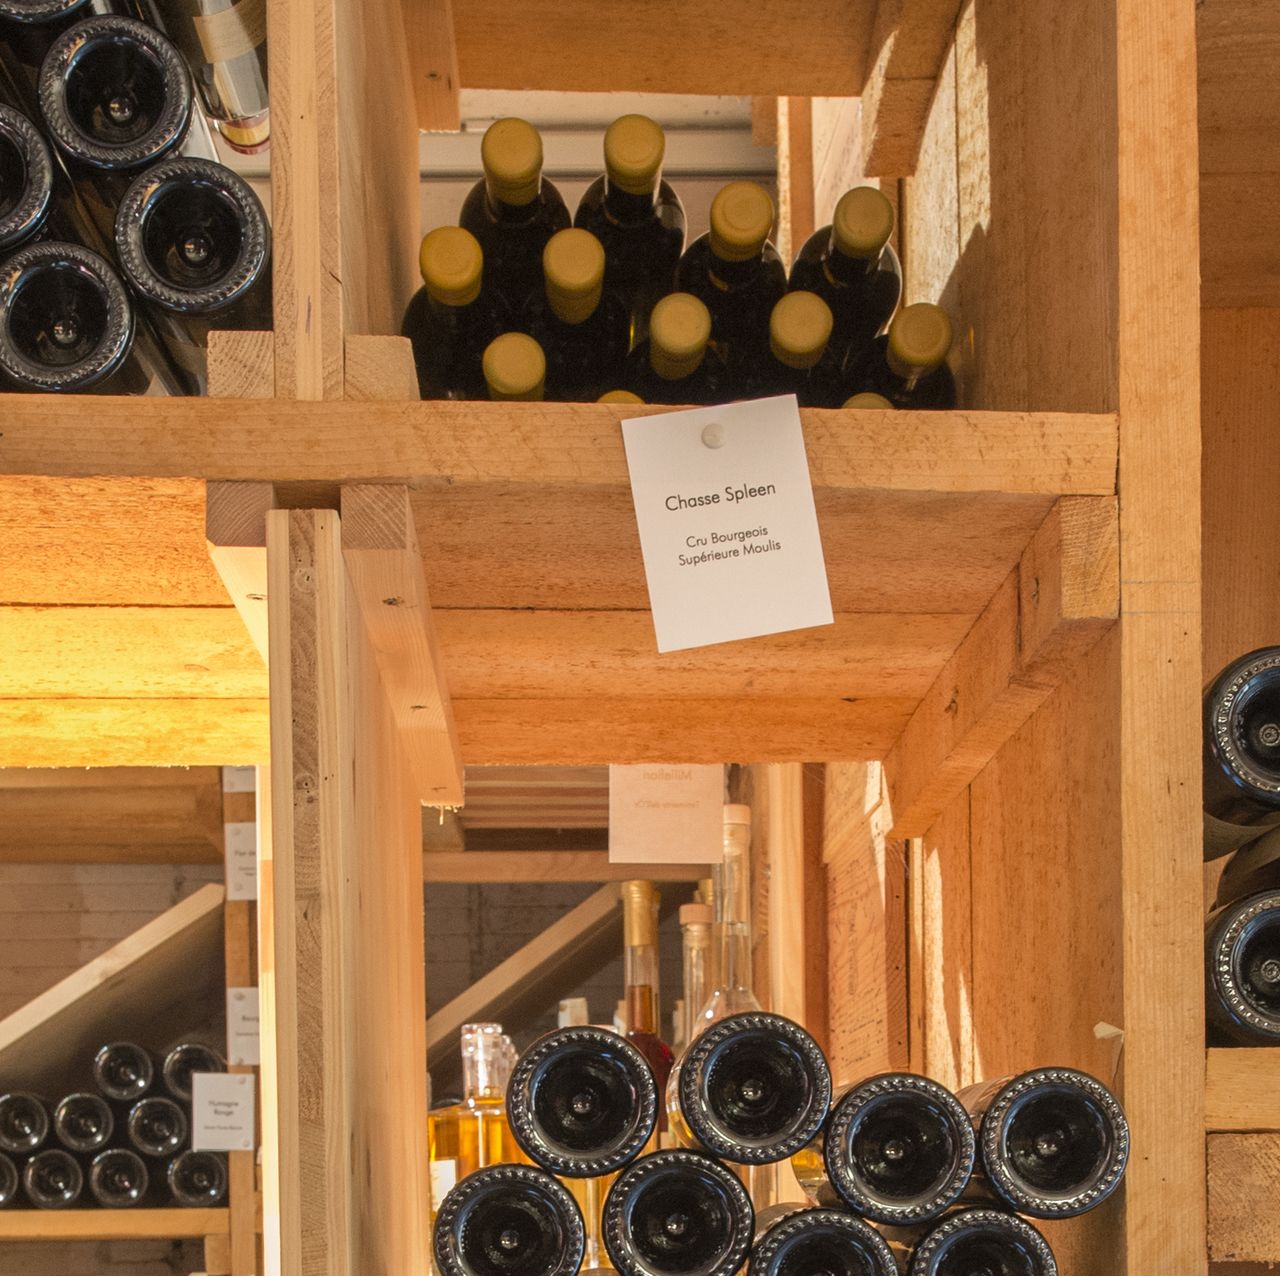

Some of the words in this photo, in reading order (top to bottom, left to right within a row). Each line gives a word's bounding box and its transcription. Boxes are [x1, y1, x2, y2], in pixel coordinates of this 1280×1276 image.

[665, 491, 721, 512] Chasse
[725, 482, 777, 504] Spleen
[686, 534, 708, 548] Cru
[711, 525, 769, 545] Bourgeois
[678, 546, 740, 567] Supérieure
[743, 538, 782, 556] Moulis
